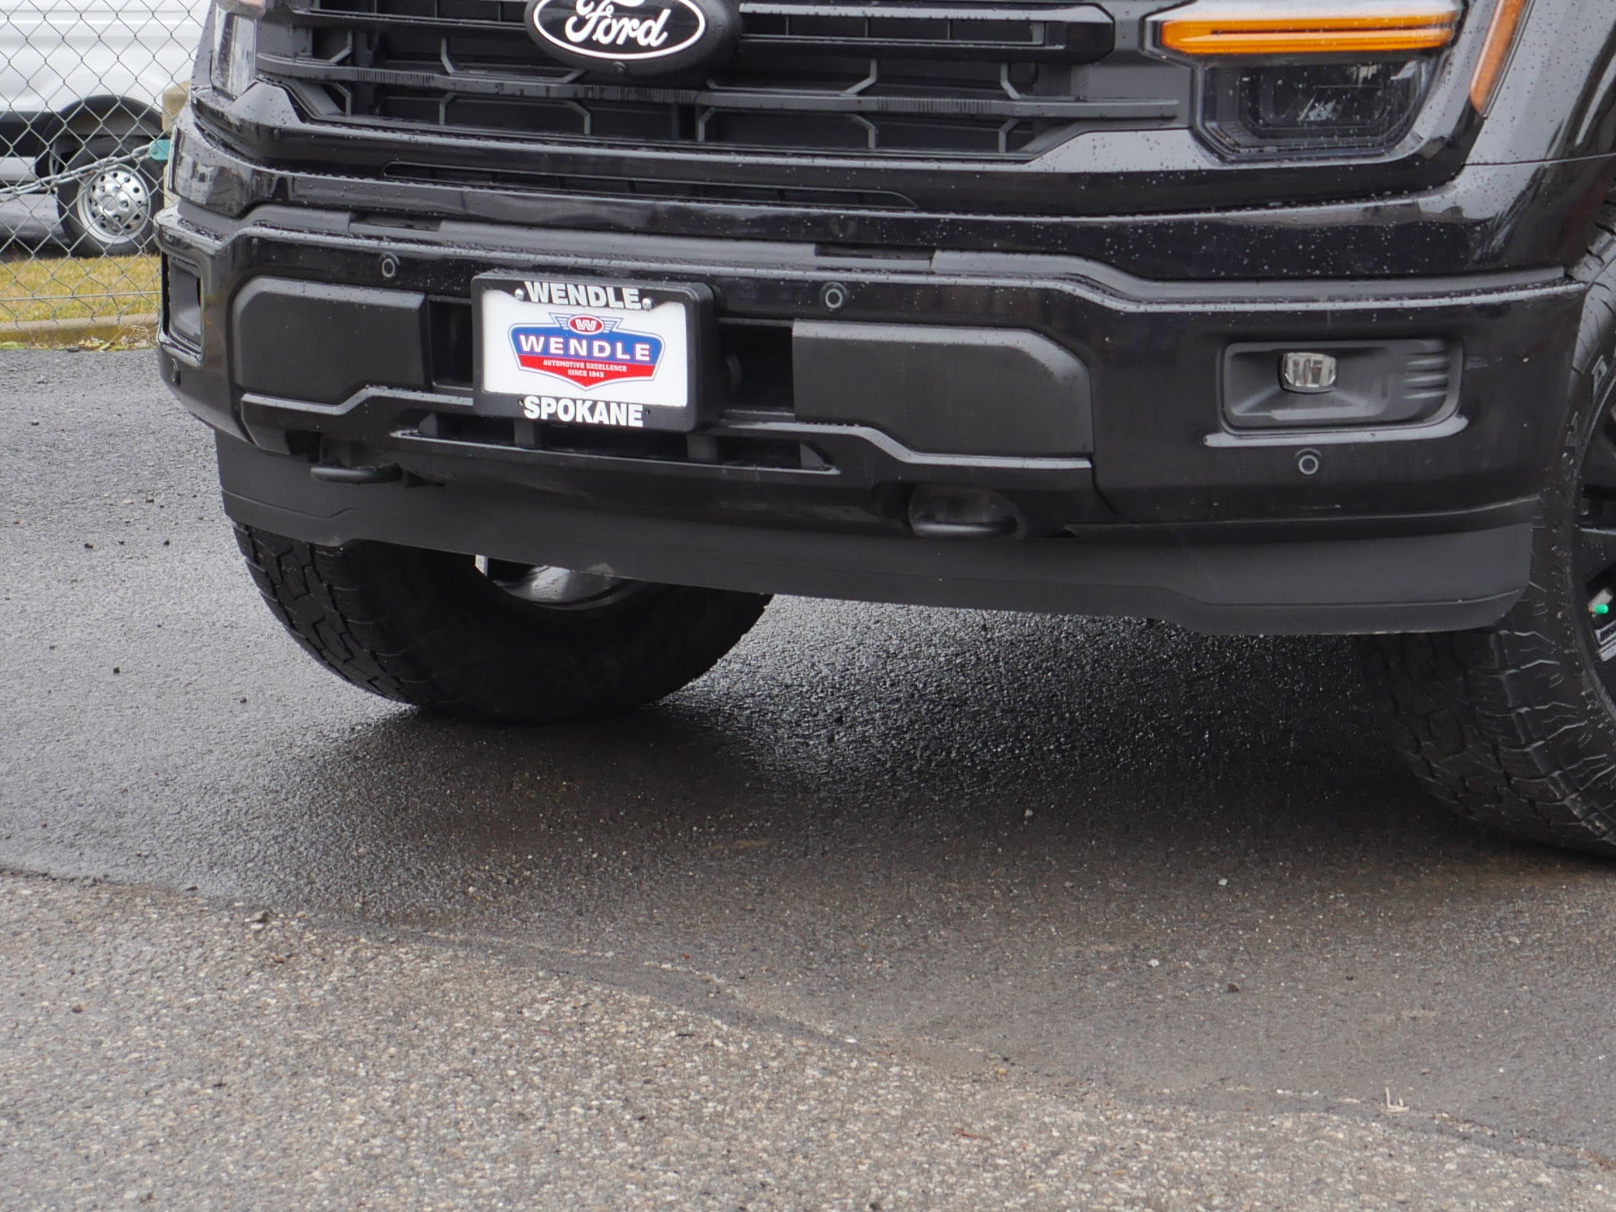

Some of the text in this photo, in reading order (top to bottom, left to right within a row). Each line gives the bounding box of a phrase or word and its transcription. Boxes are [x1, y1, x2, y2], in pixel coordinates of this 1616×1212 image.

[524, 281, 642, 310] WENDLE
[519, 334, 651, 361] WENDLE
[543, 358, 627, 372] AUTOMOTIVE EXCELLENCE
[567, 369, 588, 378] SINCE
[523, 395, 644, 428] SPOKANE
